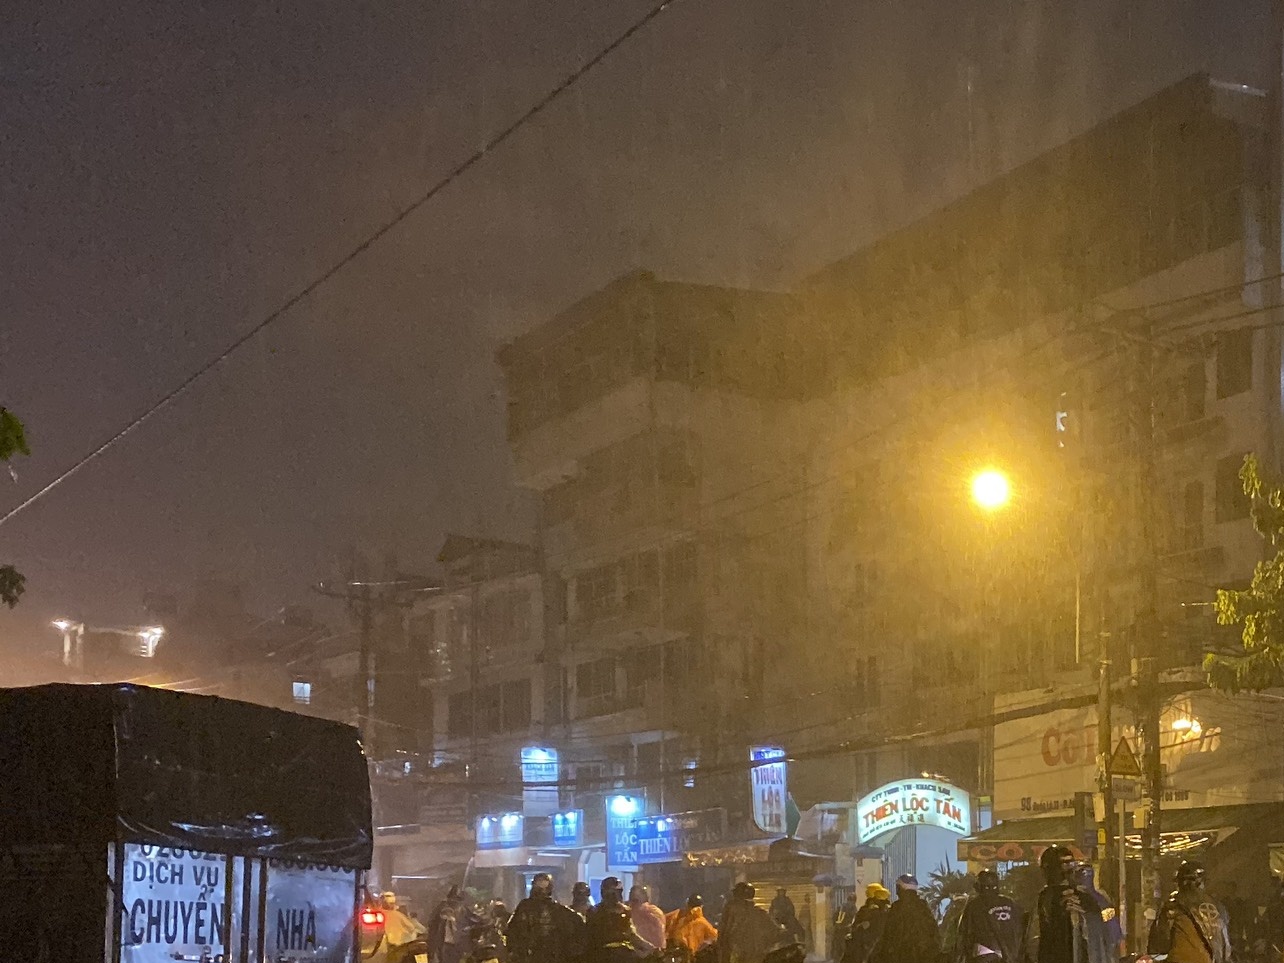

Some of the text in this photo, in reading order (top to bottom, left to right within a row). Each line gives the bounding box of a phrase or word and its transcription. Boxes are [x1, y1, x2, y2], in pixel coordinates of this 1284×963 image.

[863, 793, 962, 828] THIÊN LỘC TẤN
[615, 832, 638, 848] LỘC
[639, 834, 671, 855] THIÊN
[615, 847, 638, 862] TẤN
[132, 860, 219, 893] DỊCH VỤ
[131, 884, 318, 951] CHUYỂN NHÀ
